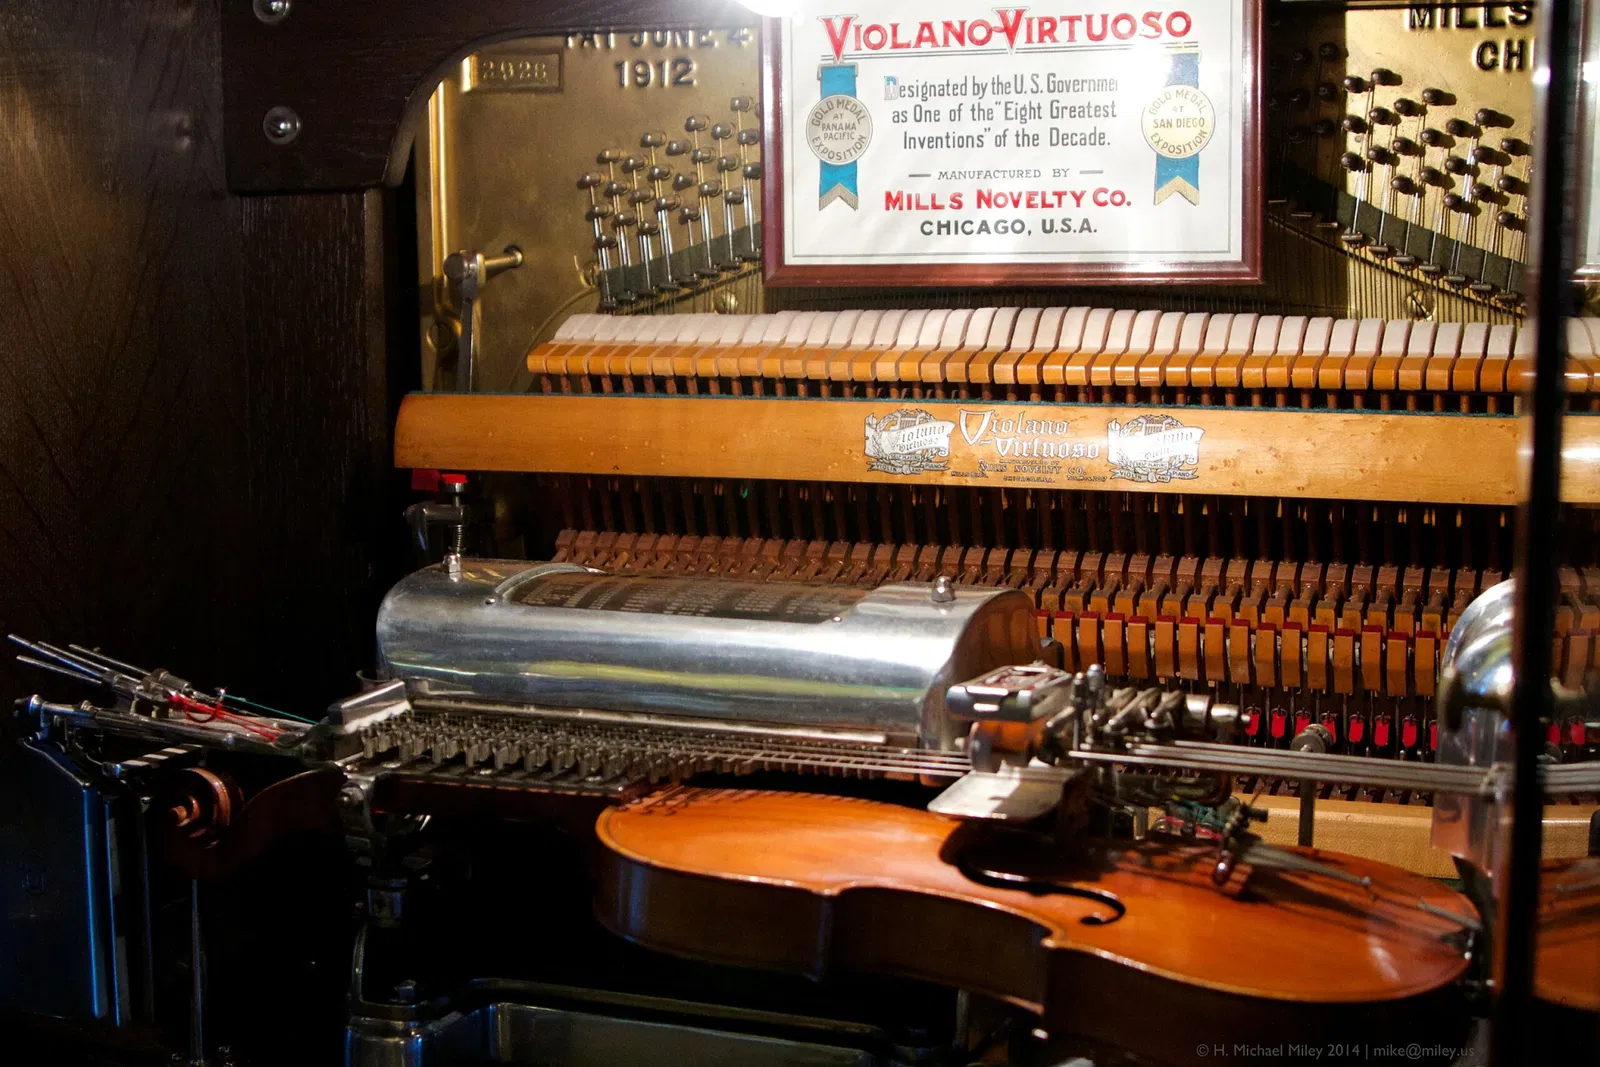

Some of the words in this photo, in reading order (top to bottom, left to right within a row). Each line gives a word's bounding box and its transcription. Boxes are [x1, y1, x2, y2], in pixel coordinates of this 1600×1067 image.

[615, 57, 697, 88] 1912
[884, 75, 968, 101] Designated
[972, 75, 988, 99] by
[991, 74, 1012, 95] the
[811, 100, 834, 127] GOLD
[836, 98, 867, 124] MEDAL
[892, 109, 908, 123] as
[913, 104, 941, 122] One
[949, 103, 964, 122] of
[970, 102, 994, 121] the
[1049, 99, 1117, 119] Greatest
[1148, 91, 1172, 115] GOLD
[1175, 88, 1207, 114] MEDAL
[821, 122, 857, 131] PANAMA
[1153, 118, 1173, 128] SAN
[1176, 117, 1205, 128] DIEGO
[811, 134, 867, 160] EXPOSITION
[823, 131, 855, 140] PACIFIC
[994, 128, 1009, 148] of
[1015, 128, 1040, 147] the
[1049, 126, 1111, 147] Decade.
[1150, 129, 1208, 154] EXPOSITION
[937, 169, 1041, 180] MANUFACTURED
[1052, 168, 1070, 178] BY
[884, 189, 963, 211] MILLS
[976, 188, 1087, 209] NOVELTY
[920, 218, 1032, 236] CHICAGO,
[1041, 217, 1097, 235] U.S.A.
[959, 408, 1069, 446] Violano
